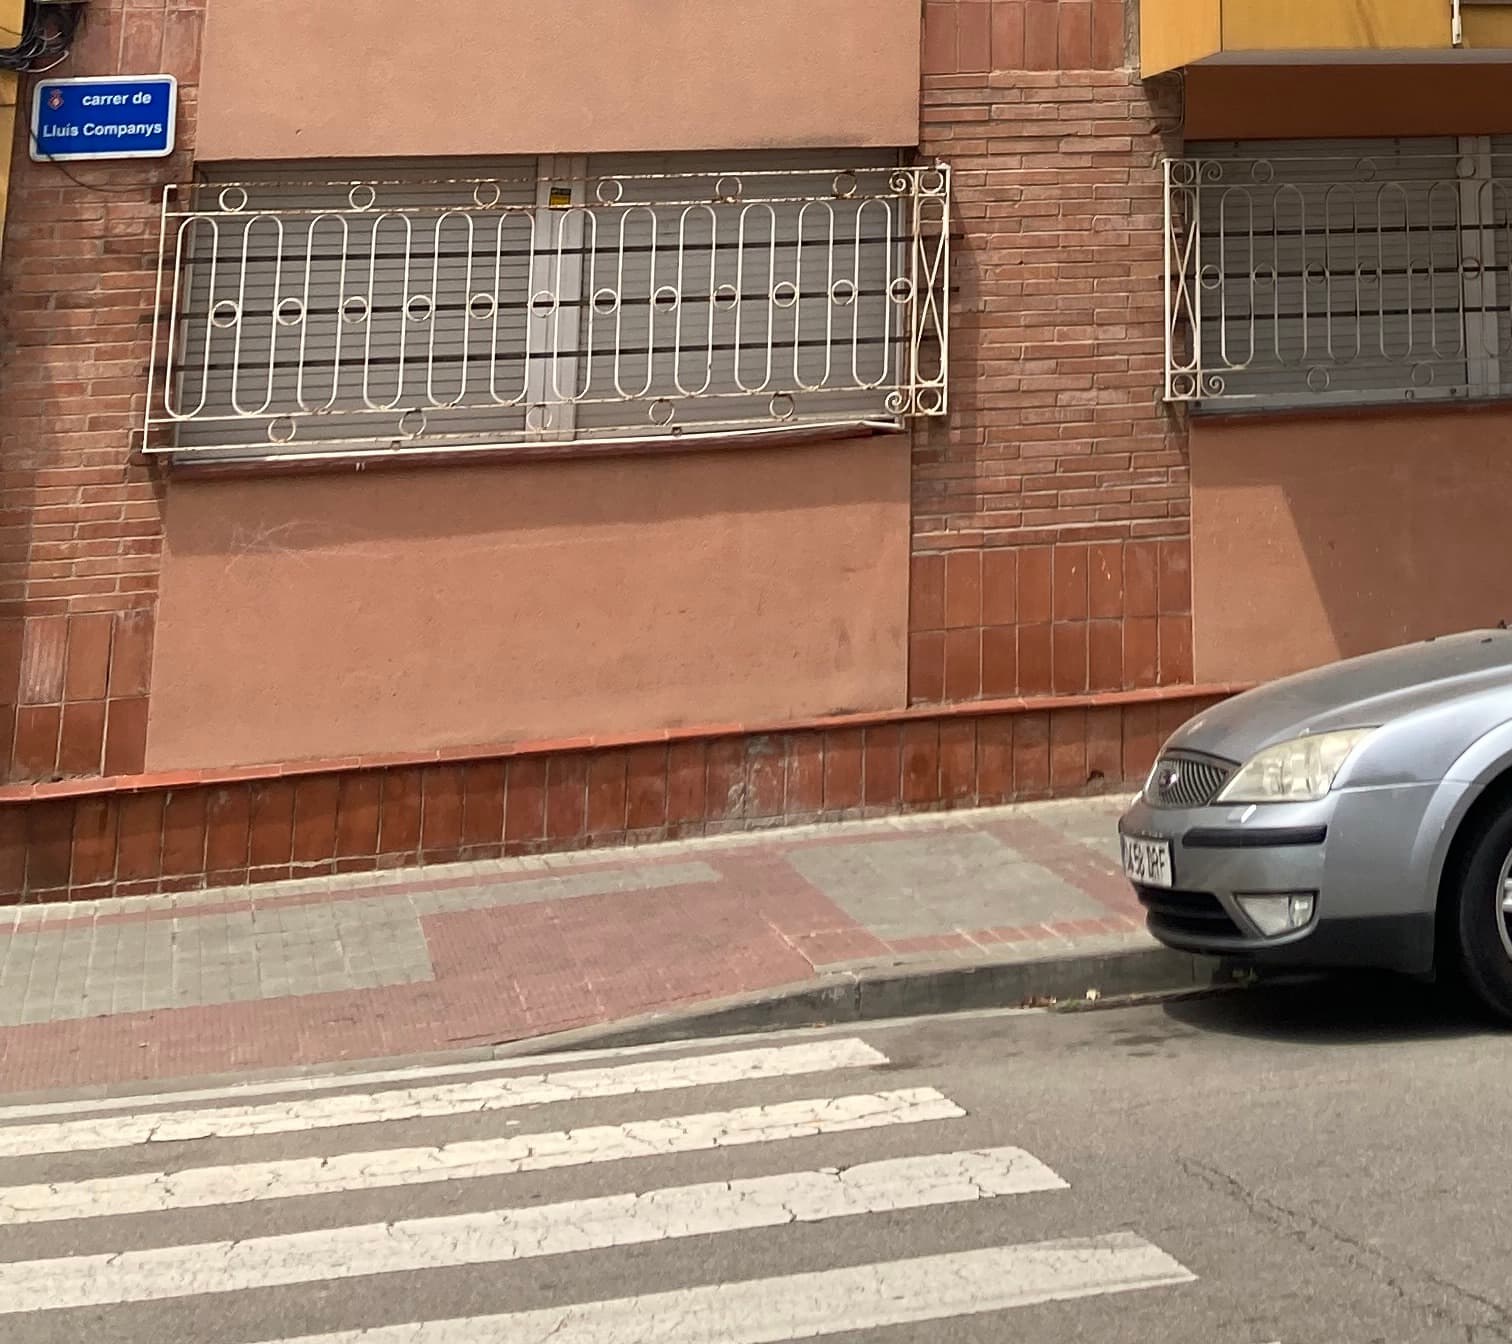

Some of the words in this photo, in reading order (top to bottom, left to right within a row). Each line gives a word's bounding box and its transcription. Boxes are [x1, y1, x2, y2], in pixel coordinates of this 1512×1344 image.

[82, 94, 129, 106] carrer
[133, 92, 152, 104] de
[42, 123, 79, 137] Lluís
[83, 123, 162, 138] Companys
